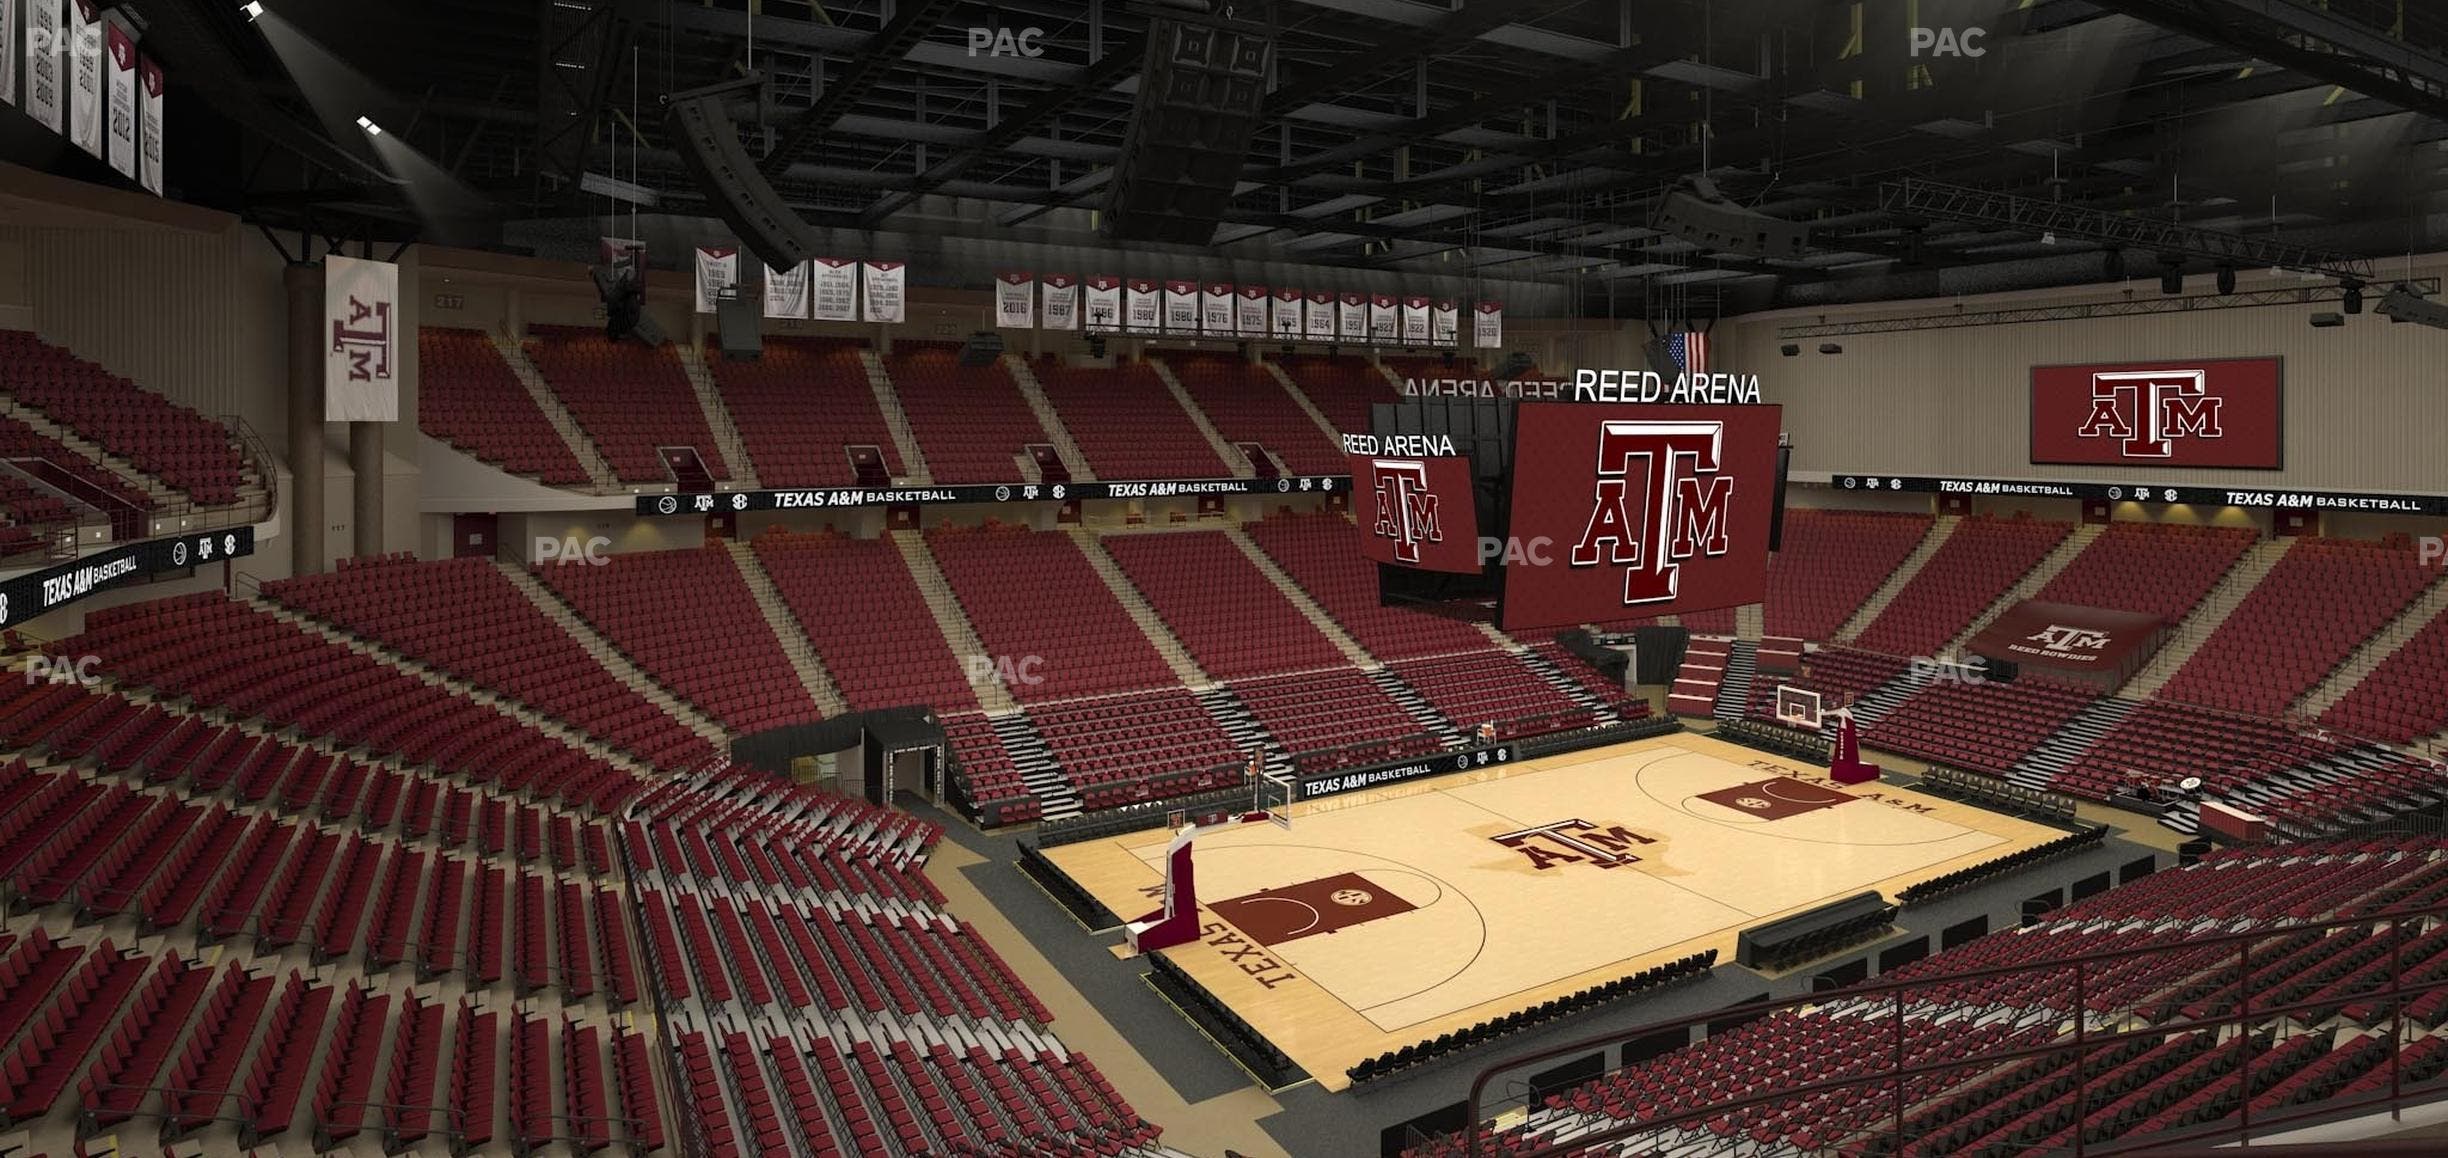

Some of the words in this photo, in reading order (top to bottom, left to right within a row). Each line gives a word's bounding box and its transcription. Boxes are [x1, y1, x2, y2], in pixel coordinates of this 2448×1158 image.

[113, 107, 130, 142] 2012
[1003, 302, 1027, 314] 2016
[1048, 304, 1071, 316] 1987
[1133, 309, 1155, 320] 1980
[1171, 310, 1192, 321] 1980
[1207, 312, 1228, 323] 1976
[1575, 368, 1661, 402] REED
[1670, 371, 1761, 404] ARENA
[1342, 433, 1378, 455] REED
[1384, 434, 1456, 456] ARENA
[1108, 483, 1147, 497] TEXAS
[1149, 482, 1178, 496] A&M
[1178, 482, 1248, 493] BASKETBALL
[1940, 480, 1973, 493] TEXAS
[1974, 482, 2001, 494] A&M
[2001, 485, 2073, 496] BASKETBALL
[774, 492, 826, 508] TEXAS
[828, 490, 864, 506] A&M
[866, 490, 957, 503] BASKETBALL
[2226, 491, 2274, 507] TEXAS
[2276, 493, 2314, 509] A&M
[2316, 496, 2422, 512] BASKETBALL
[42, 575, 73, 607] TEXAS
[72, 565, 94, 597] A&M
[93, 555, 137, 584] BASKETBALL
[2008, 644, 2040, 654] REED
[2040, 650, 2098, 661] ROWDIES
[1304, 779, 1341, 797] TEXAS
[1342, 773, 1367, 791] A&M
[1368, 764, 1431, 783] BASKETBALL
[1748, 760, 1843, 789] TEXAS
[1859, 792, 1936, 814] A&M
[1200, 922, 1296, 990] TEXAS
